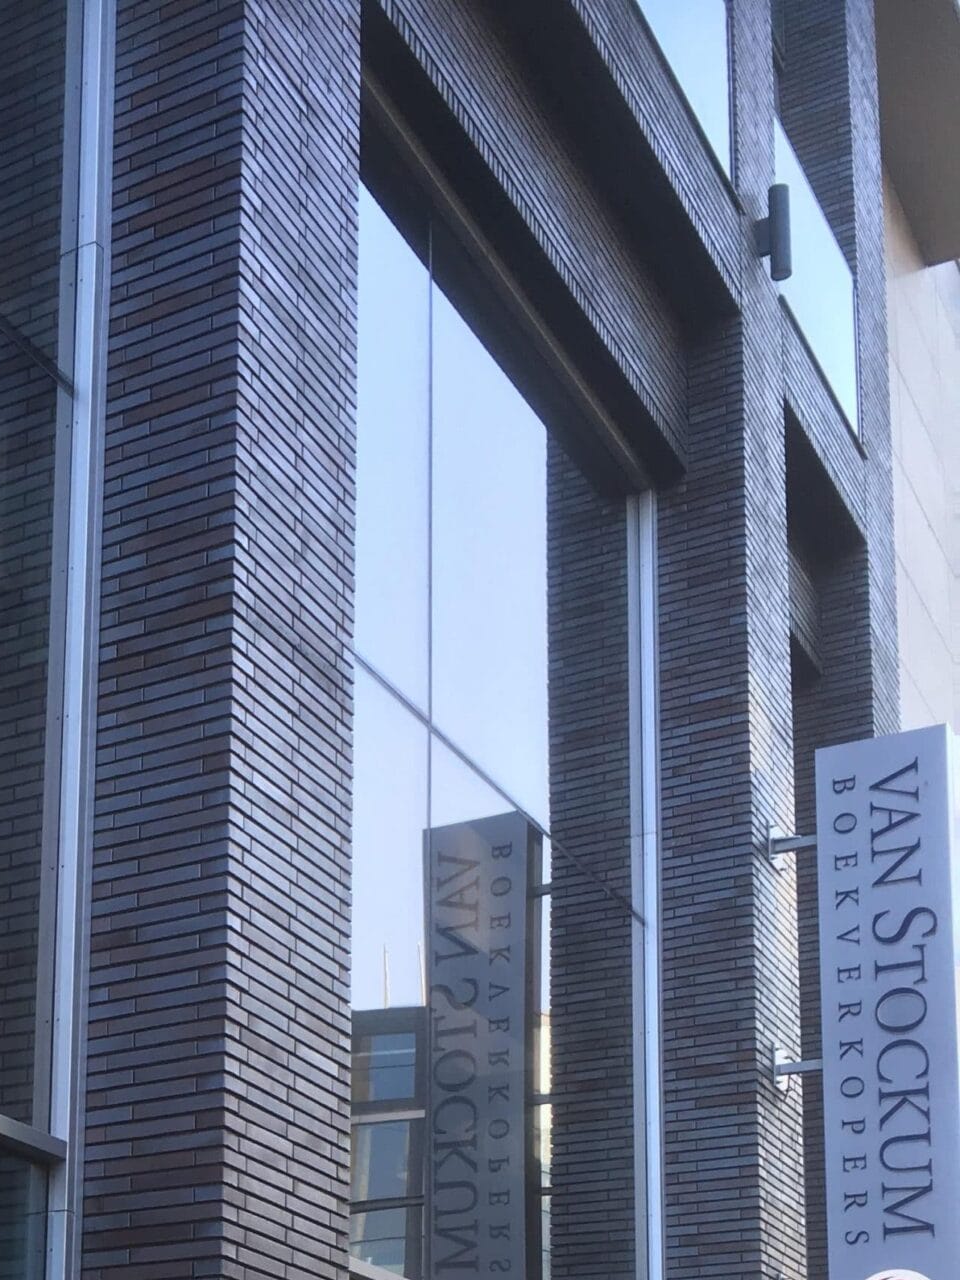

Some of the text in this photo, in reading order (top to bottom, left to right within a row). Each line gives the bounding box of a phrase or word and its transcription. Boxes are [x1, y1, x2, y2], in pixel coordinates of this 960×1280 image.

[832, 775, 871, 1247] BOEKVERKOPERS
[869, 756, 939, 1242] VAN STOCKUM
